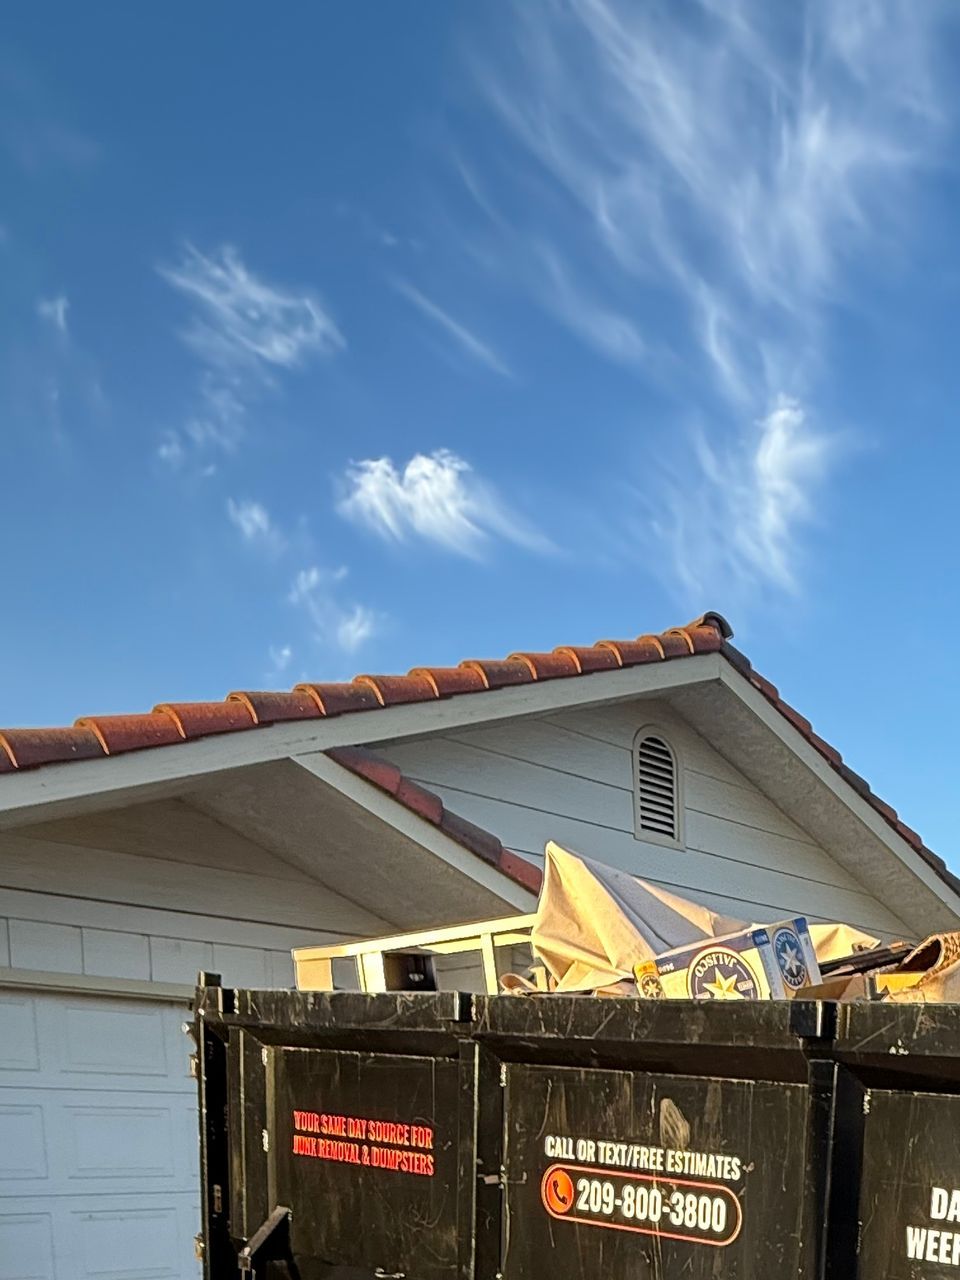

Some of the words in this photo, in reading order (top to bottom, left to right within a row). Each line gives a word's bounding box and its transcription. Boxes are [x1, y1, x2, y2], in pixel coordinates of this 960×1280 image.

[694, 952, 738, 978] JALISCO
[293, 1110, 320, 1133] YOUR
[320, 1114, 347, 1139] SAME
[347, 1117, 367, 1139] DAY
[368, 1120, 410, 1146] SOURCE
[411, 1126, 434, 1149] FOR
[293, 1135, 317, 1156] JUNK
[317, 1138, 361, 1164] REMOVAL
[361, 1145, 370, 1165] &
[371, 1146, 434, 1176] DUMPSTERS
[545, 1135, 576, 1160] CALL
[576, 1139, 595, 1162] OR
[597, 1141, 664, 1171] TEXT/FREE
[666, 1149, 742, 1181] ESTIMATES
[576, 1178, 727, 1233] 209-800-3800
